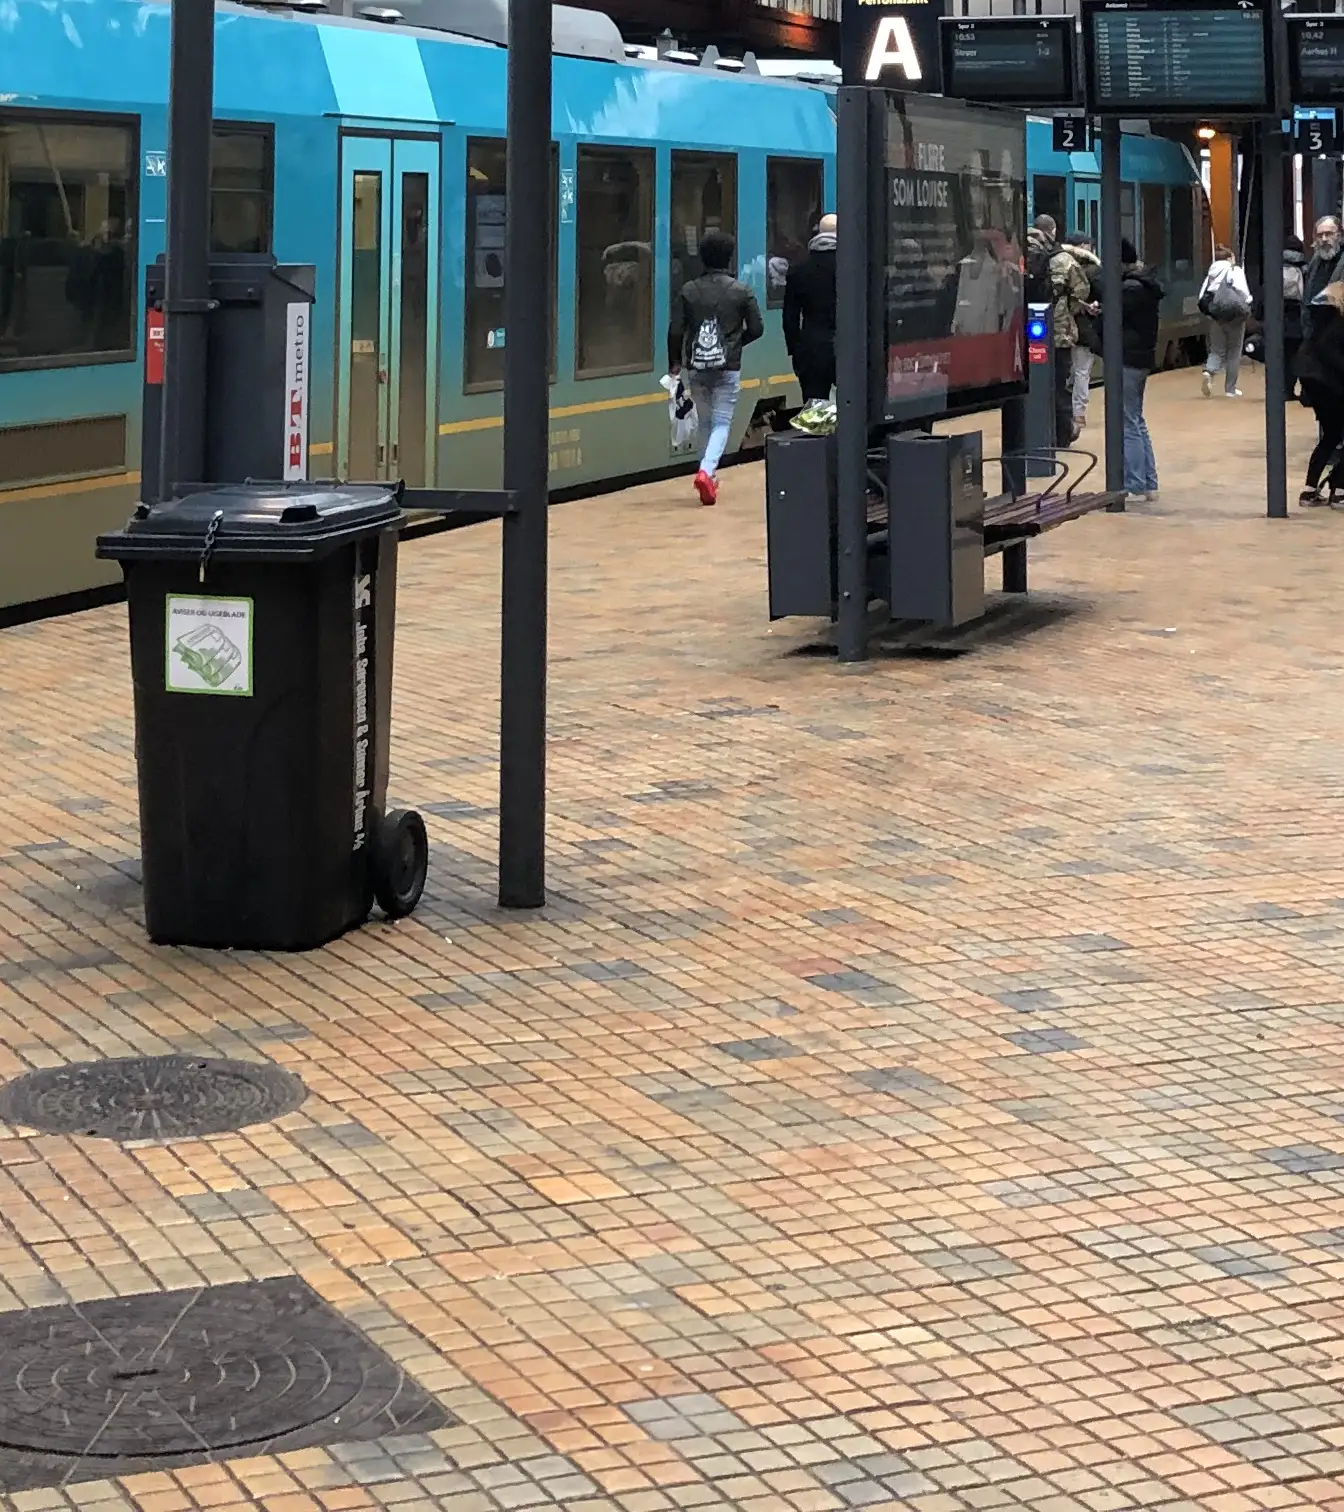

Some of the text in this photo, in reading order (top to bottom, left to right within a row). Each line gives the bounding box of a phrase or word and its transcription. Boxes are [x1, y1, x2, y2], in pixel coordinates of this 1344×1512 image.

[864, 16, 923, 80] A
[1062, 129, 1075, 147] 2
[1309, 131, 1323, 150] 3
[893, 178, 948, 208] SOM LOUISE
[294, 315, 305, 385] metro
